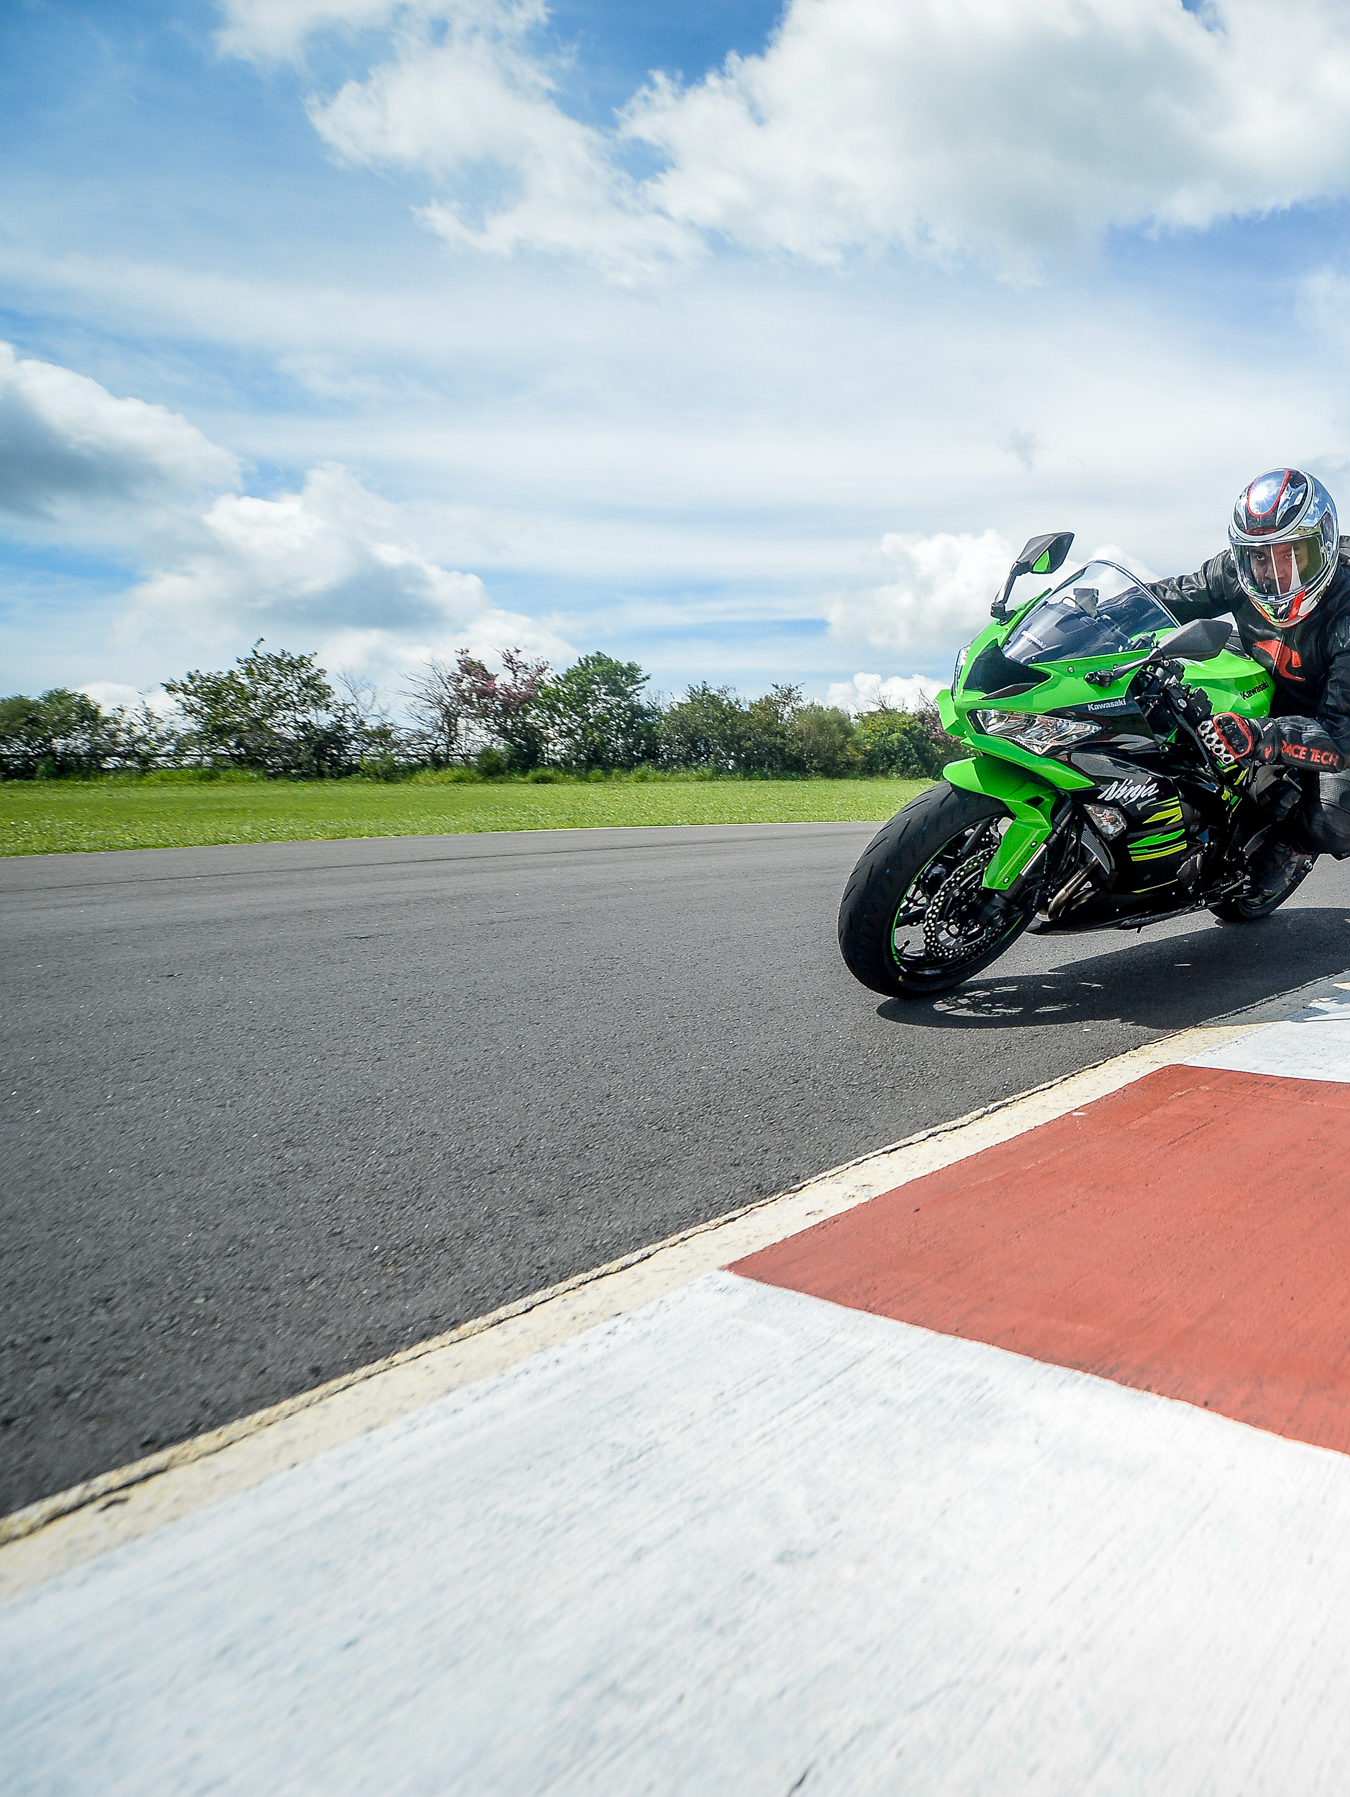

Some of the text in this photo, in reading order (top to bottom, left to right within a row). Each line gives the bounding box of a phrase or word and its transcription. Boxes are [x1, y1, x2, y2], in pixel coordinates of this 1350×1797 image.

[1239, 679, 1269, 700] Kawasaki
[1087, 700, 1127, 712] Kawasaki
[1310, 748, 1340, 767] TECH
[1098, 777, 1159, 806] Ninja
